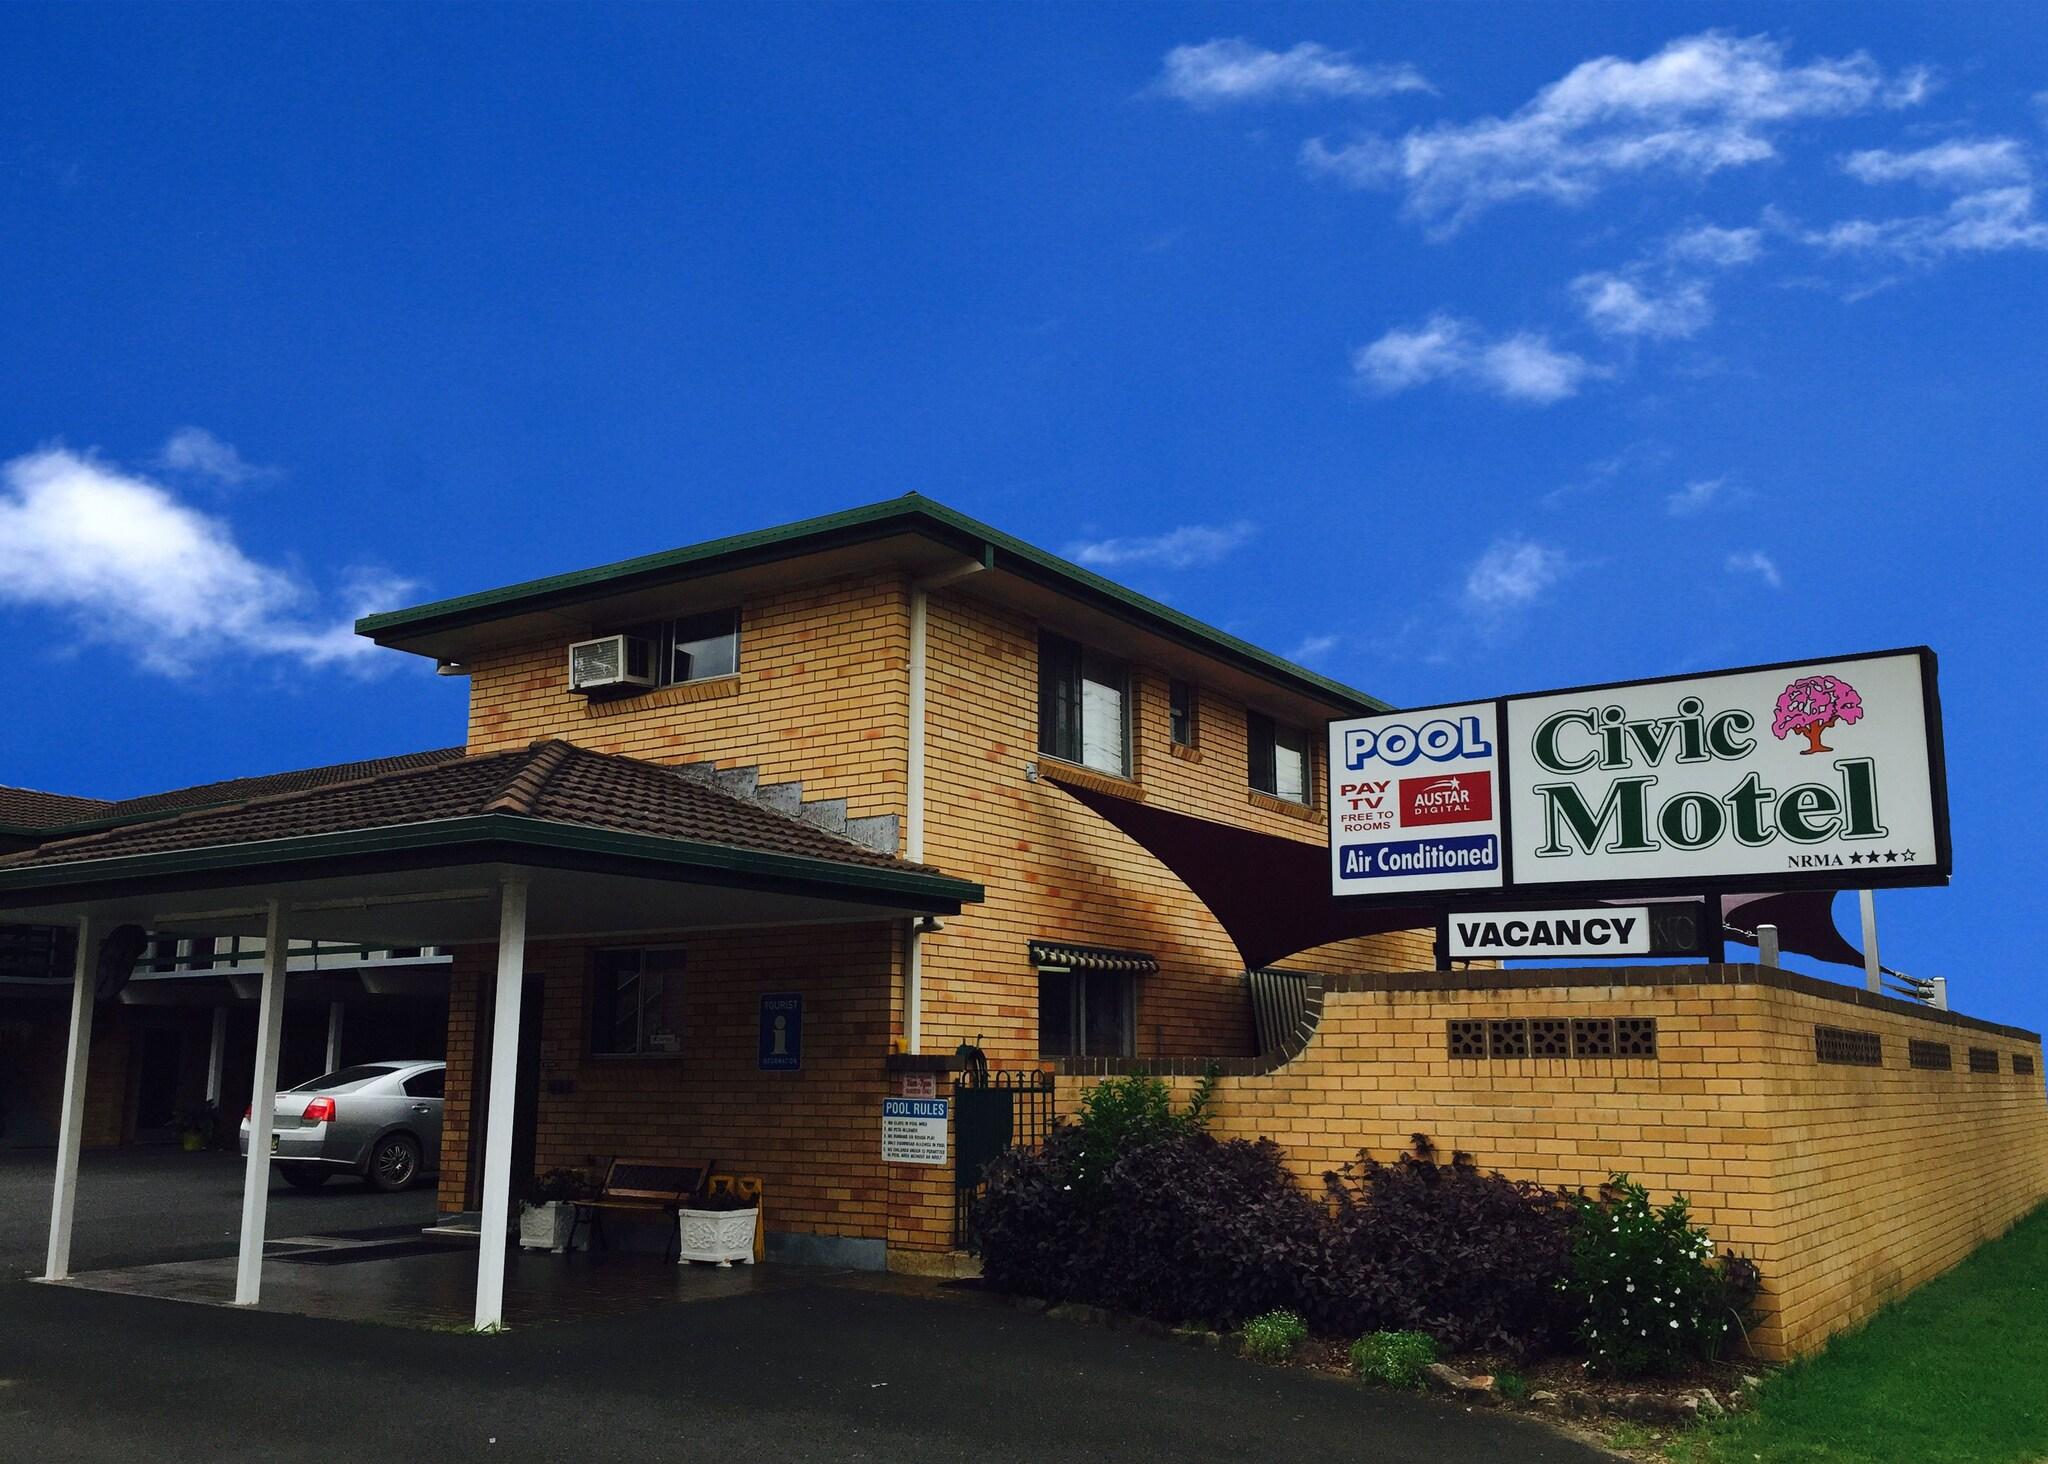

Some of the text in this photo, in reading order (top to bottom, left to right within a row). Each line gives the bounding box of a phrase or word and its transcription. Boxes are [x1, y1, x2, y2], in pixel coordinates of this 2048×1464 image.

[1345, 716, 1492, 770] POOL
[1531, 696, 1757, 775] Civic
[1340, 780, 1391, 796] PAY
[1347, 797, 1383, 810] TV
[1414, 789, 1470, 807] AUSTAR
[1414, 804, 1470, 815] DIGITAL
[1532, 757, 1888, 858] Motel
[1341, 811, 1394, 822] FREE TO
[1344, 822, 1391, 832] ROOMS
[1346, 839, 1493, 873] Air Conditioned
[1788, 854, 1844, 868] NRMA
[1457, 918, 1636, 947] VACANCY
[764, 1000, 798, 1009] TOURIST
[886, 1102, 944, 1116] POOL RULES
